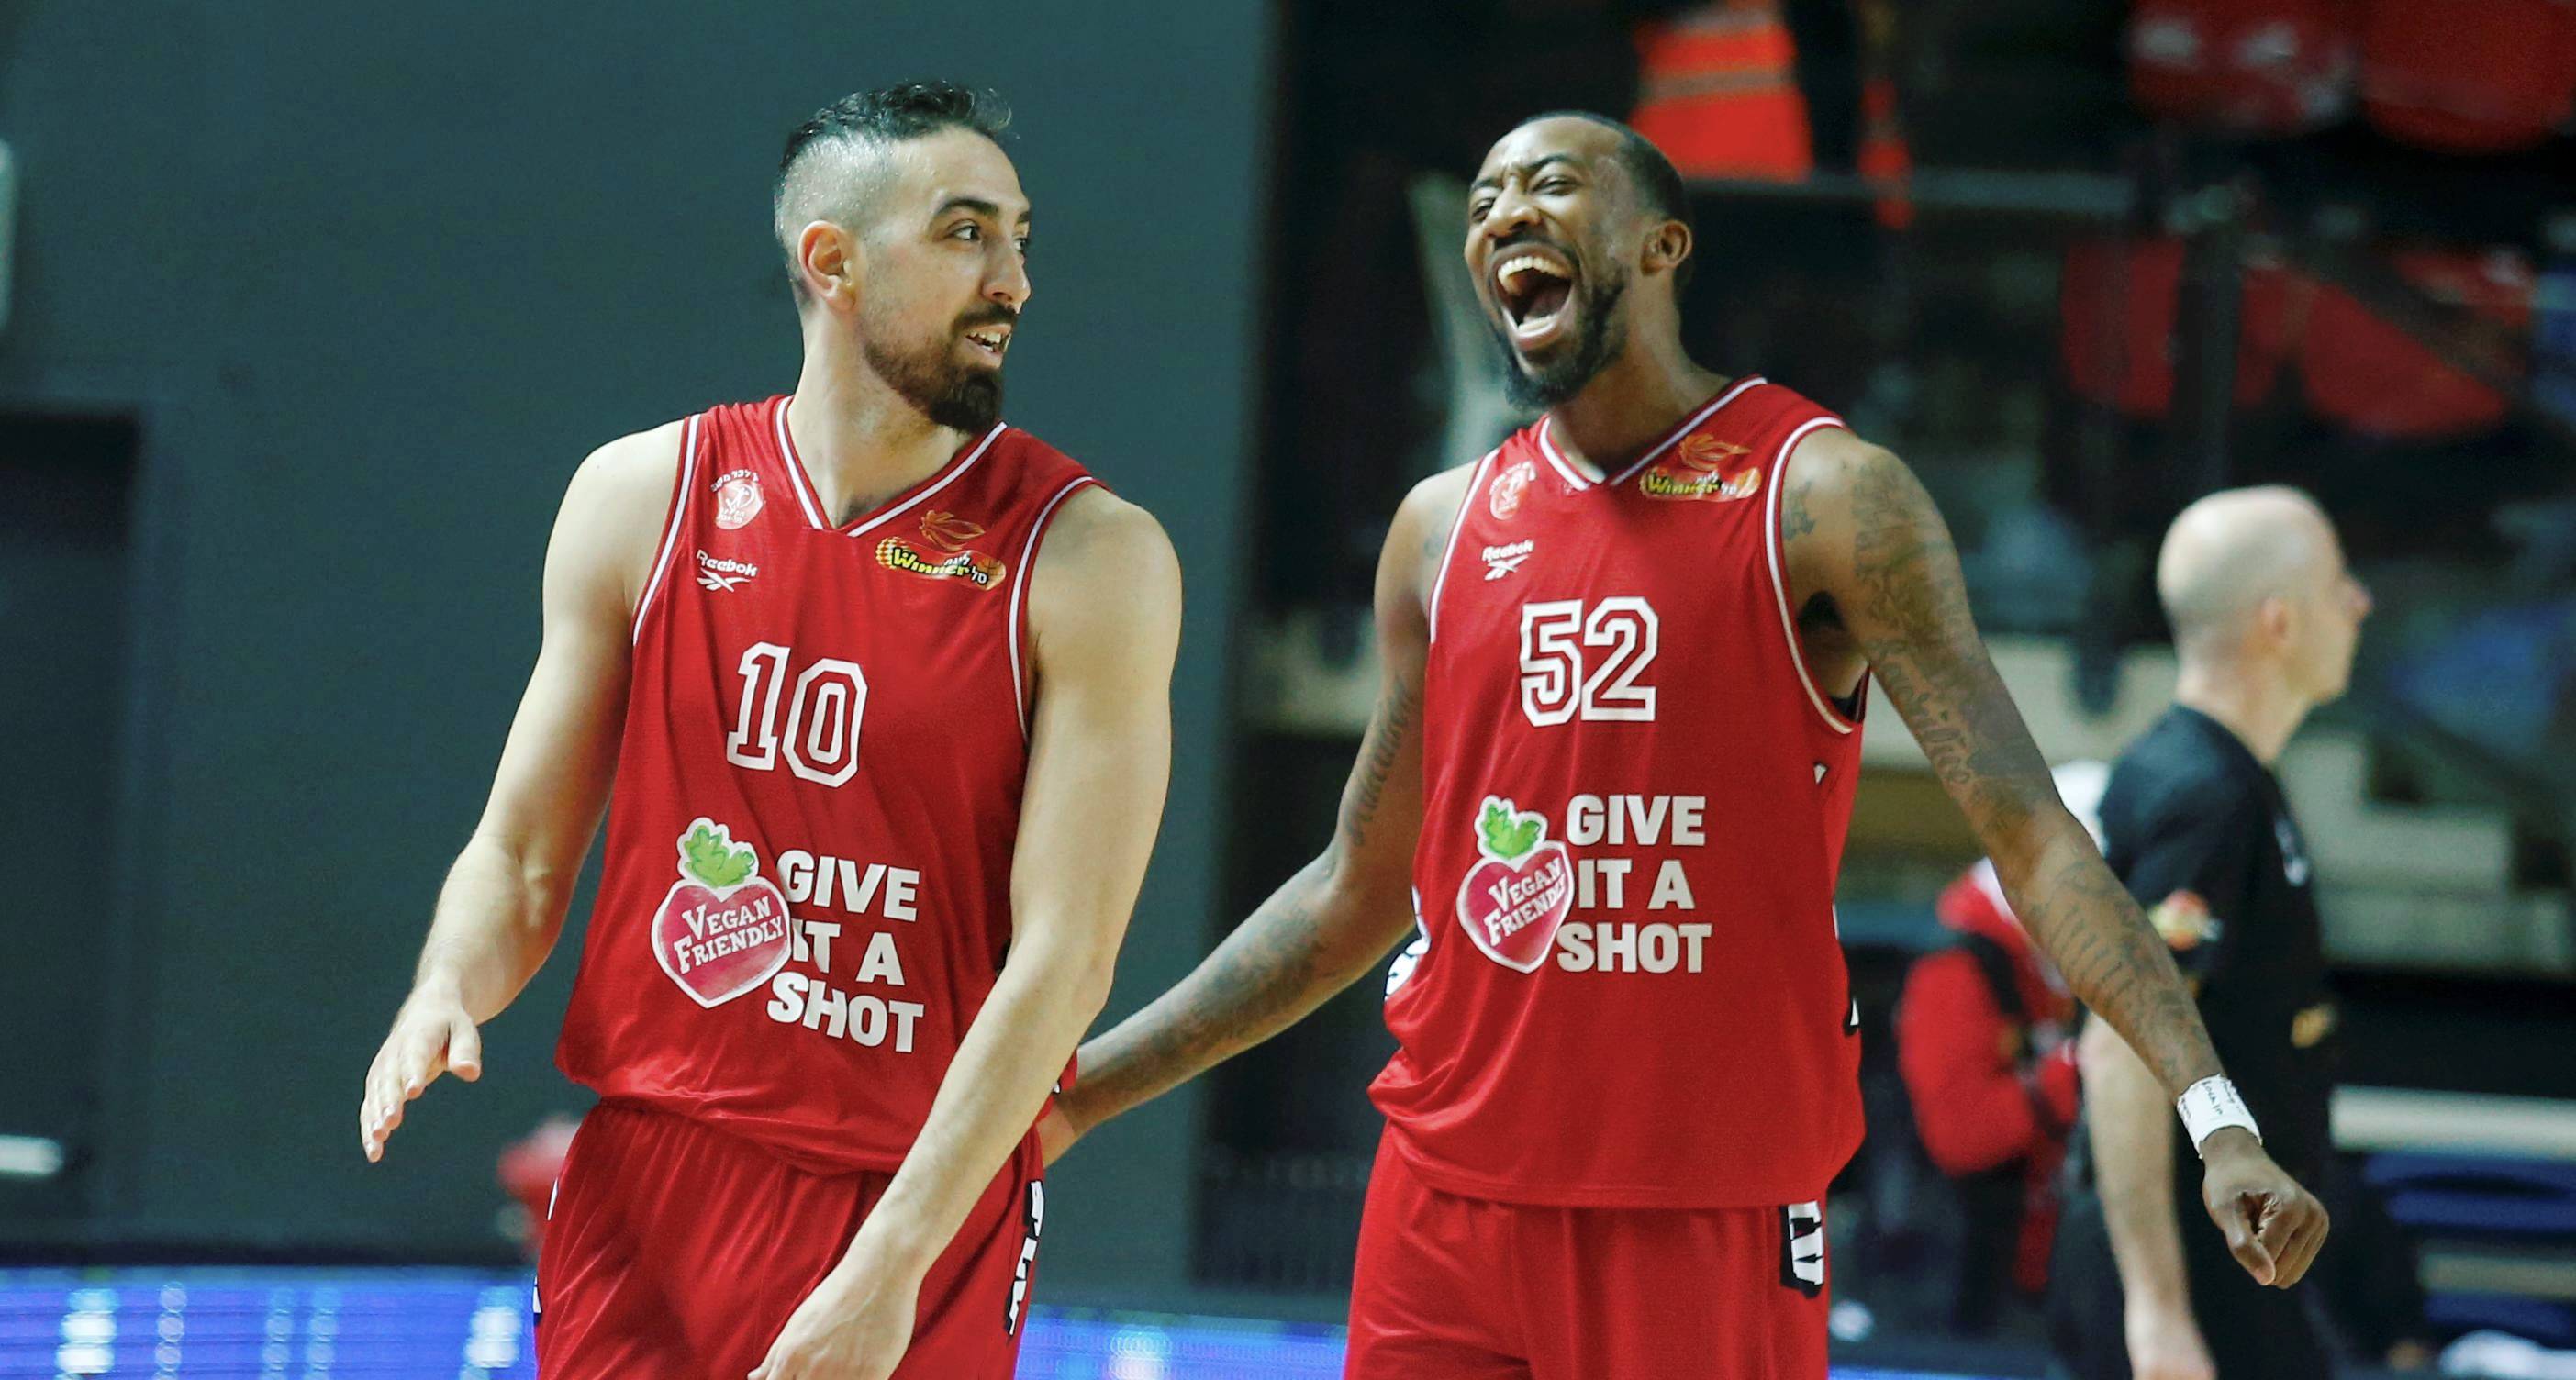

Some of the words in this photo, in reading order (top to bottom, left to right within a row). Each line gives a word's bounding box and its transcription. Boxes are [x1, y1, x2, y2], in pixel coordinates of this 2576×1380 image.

[697, 550, 758, 577] Reebok
[893, 548, 970, 576] Winner
[1482, 540, 1534, 562] Reebok
[1520, 596, 1659, 726] 52
[727, 641, 868, 788] 10
[1566, 794, 1706, 846] GIVE
[777, 850, 920, 922] GIVE
[1483, 873, 1566, 947] FRIENDLY
[1488, 857, 1561, 912] VEGAN
[1578, 858, 1632, 909] IT
[1647, 860, 1695, 910] A
[674, 916, 784, 974] FRIENDLY
[681, 896, 771, 940] VEGAN
[791, 918, 841, 974] IT
[855, 932, 905, 986] A
[1556, 921, 1712, 974] SHOT
[767, 972, 925, 1052] SHOT
